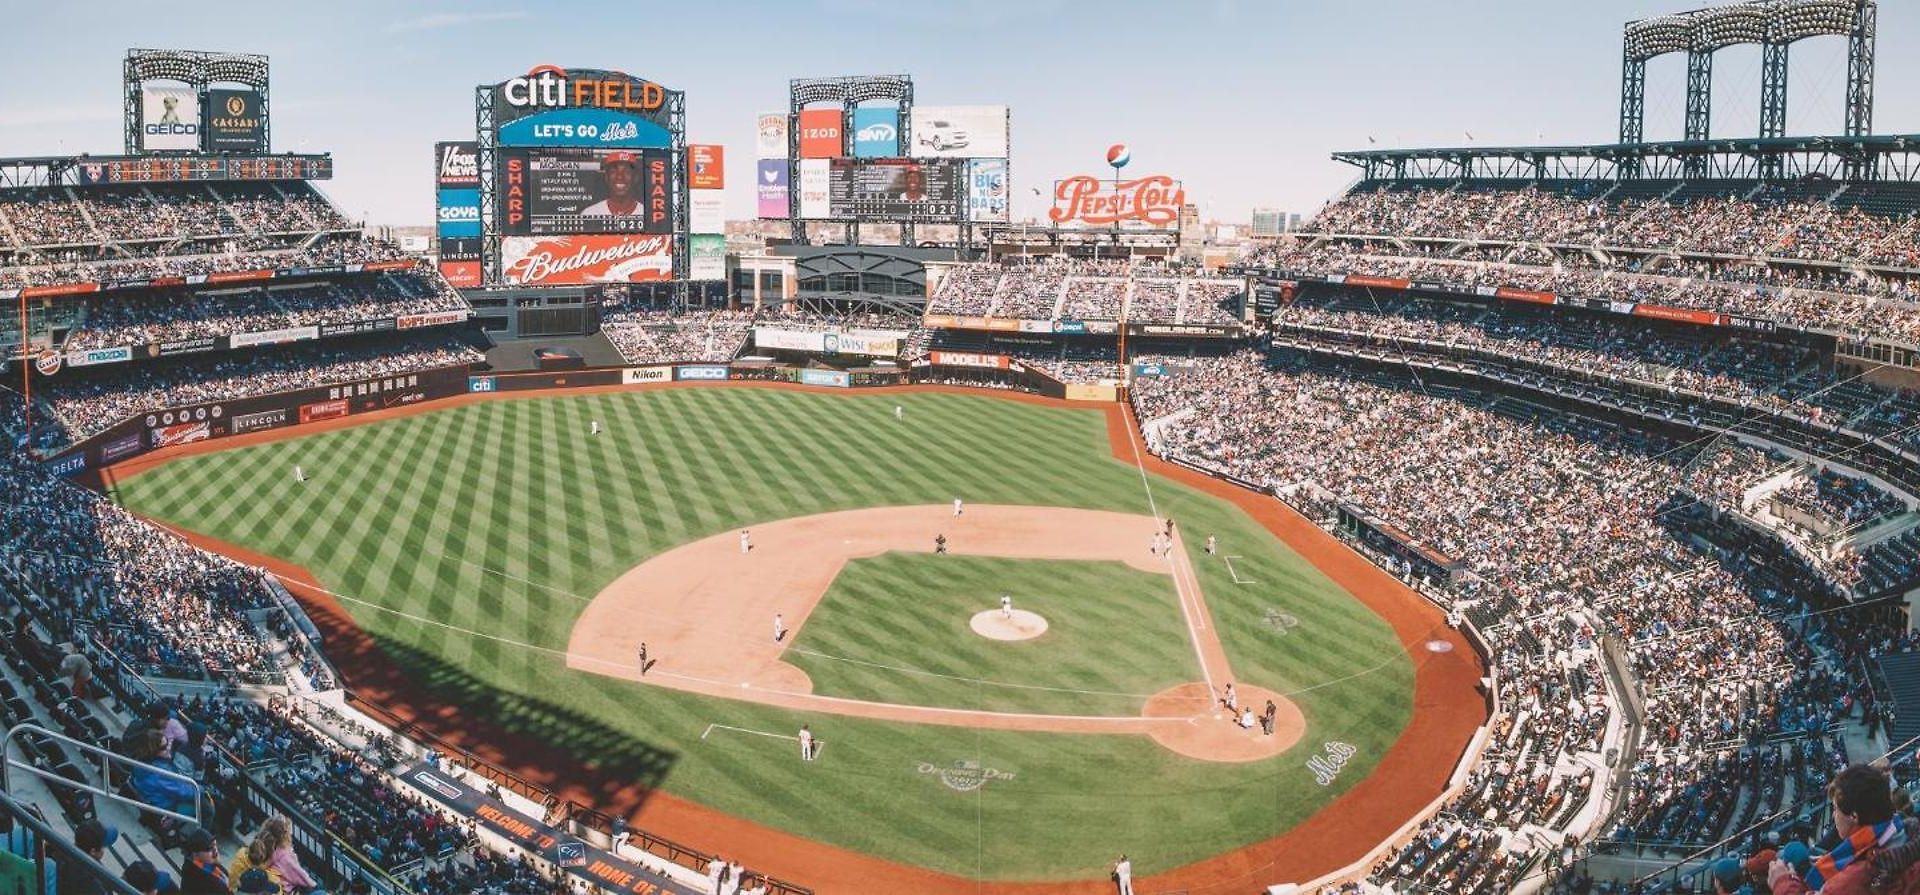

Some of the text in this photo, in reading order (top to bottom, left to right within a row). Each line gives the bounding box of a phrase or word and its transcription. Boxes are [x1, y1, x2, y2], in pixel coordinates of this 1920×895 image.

[574, 79, 664, 109] FIELD
[146, 123, 197, 135] GEICO
[212, 118, 258, 128] CAESARS
[534, 121, 639, 142] LET'S GO Mets
[803, 128, 838, 139] IZOD
[856, 126, 893, 141] SNY
[453, 154, 477, 165] FOX
[445, 165, 478, 176] NEWS
[975, 174, 1001, 188] BIG
[507, 159, 523, 225] SHARP
[651, 160, 666, 224] SHARP
[971, 198, 1004, 209] BARS
[440, 206, 479, 219] GOYA
[620, 221, 626, 229] 0
[629, 221, 635, 229] 2
[638, 221, 644, 229] 0
[513, 235, 663, 283] Budweiser
[841, 336, 865, 350] WISE
[941, 352, 1000, 367] MODELL'S
[632, 370, 663, 380] Nikon
[680, 367, 727, 379] GEICO
[472, 379, 491, 391] citi
[238, 414, 286, 428] LINCOLN
[53, 458, 85, 475] DELTA
[1305, 741, 1356, 785] Mets
[475, 804, 556, 849] WELCOME TO
[587, 860, 658, 895] HOME OF
